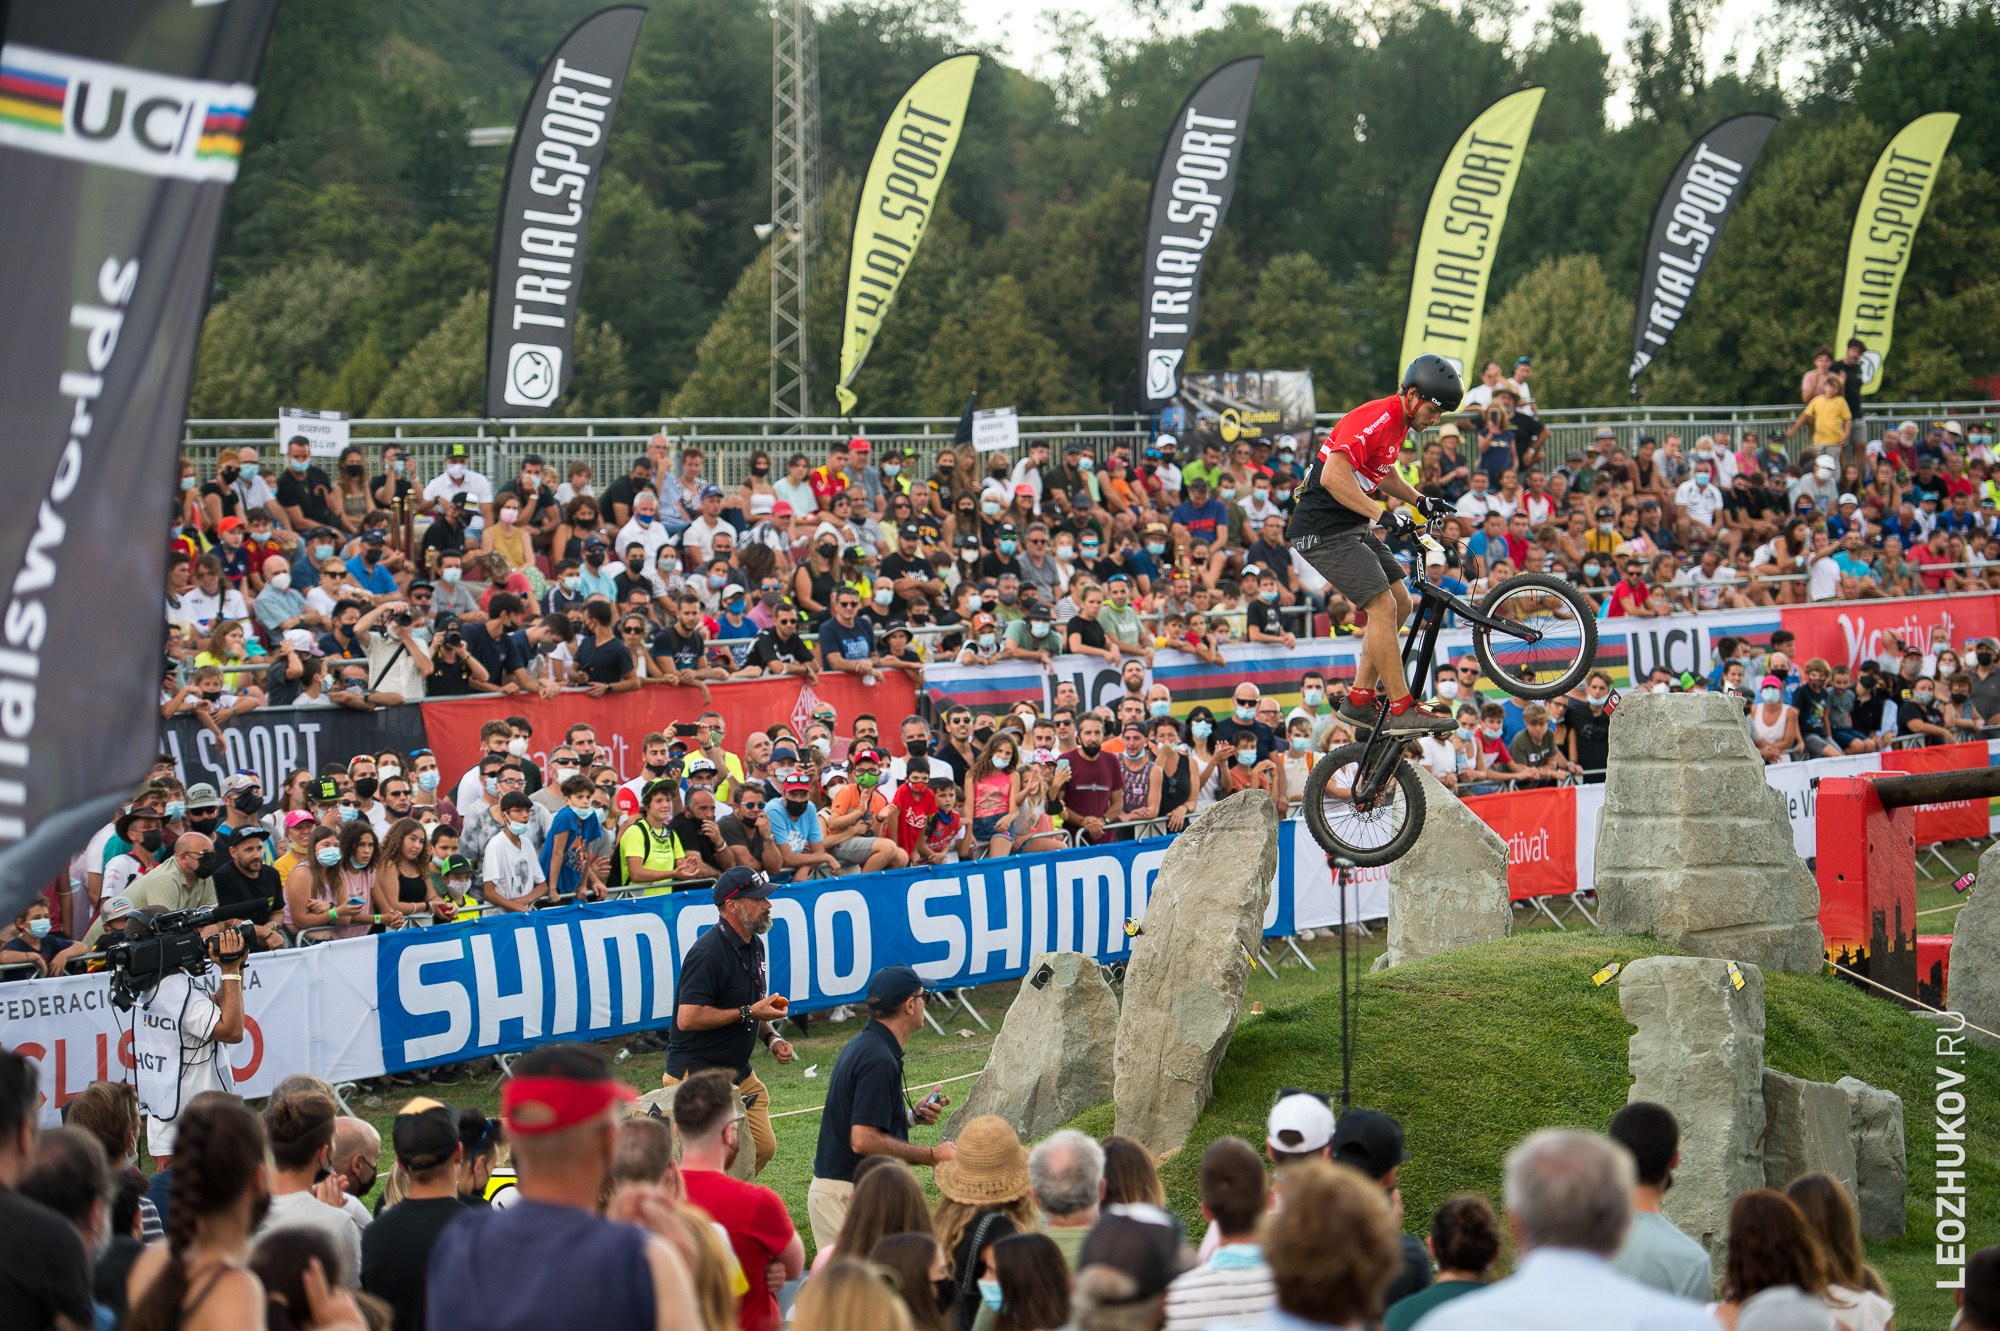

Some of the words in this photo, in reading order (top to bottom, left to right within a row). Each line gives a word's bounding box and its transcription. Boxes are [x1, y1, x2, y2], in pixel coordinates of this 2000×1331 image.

[72, 80, 197, 157] UCI
[513, 58, 613, 331] TRIALSPORT
[856, 99, 951, 336] RIALSPORT
[1149, 107, 1238, 339] TRIALSPORT
[1423, 132, 1513, 342] TRIALSPORT
[1631, 628, 1699, 684] UCI
